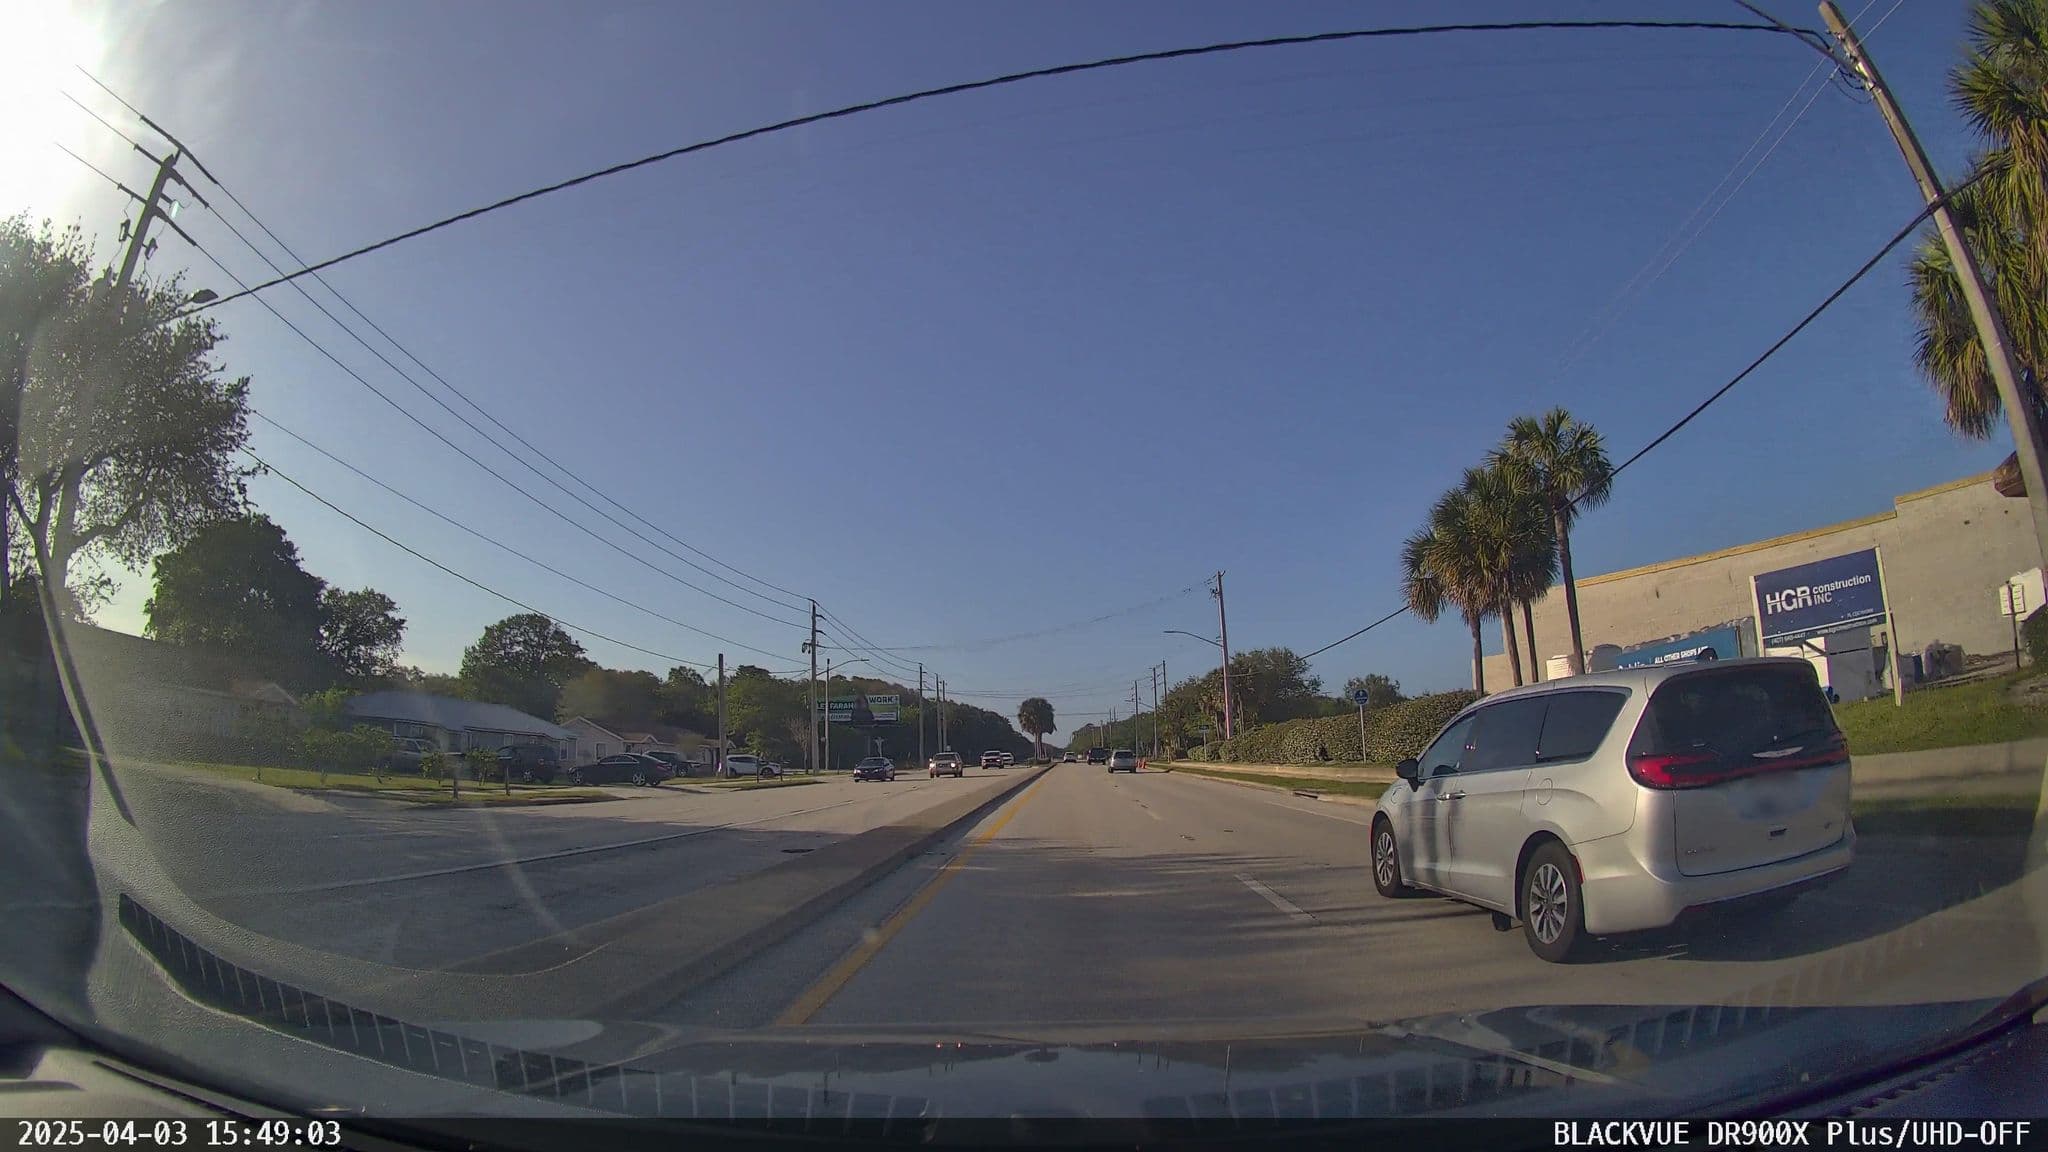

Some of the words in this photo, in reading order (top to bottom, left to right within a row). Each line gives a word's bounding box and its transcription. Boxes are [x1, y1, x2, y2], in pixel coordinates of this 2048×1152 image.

[1766, 586, 1813, 615] HGR
[1813, 575, 1871, 594] construction
[1813, 592, 1832, 605] INC
